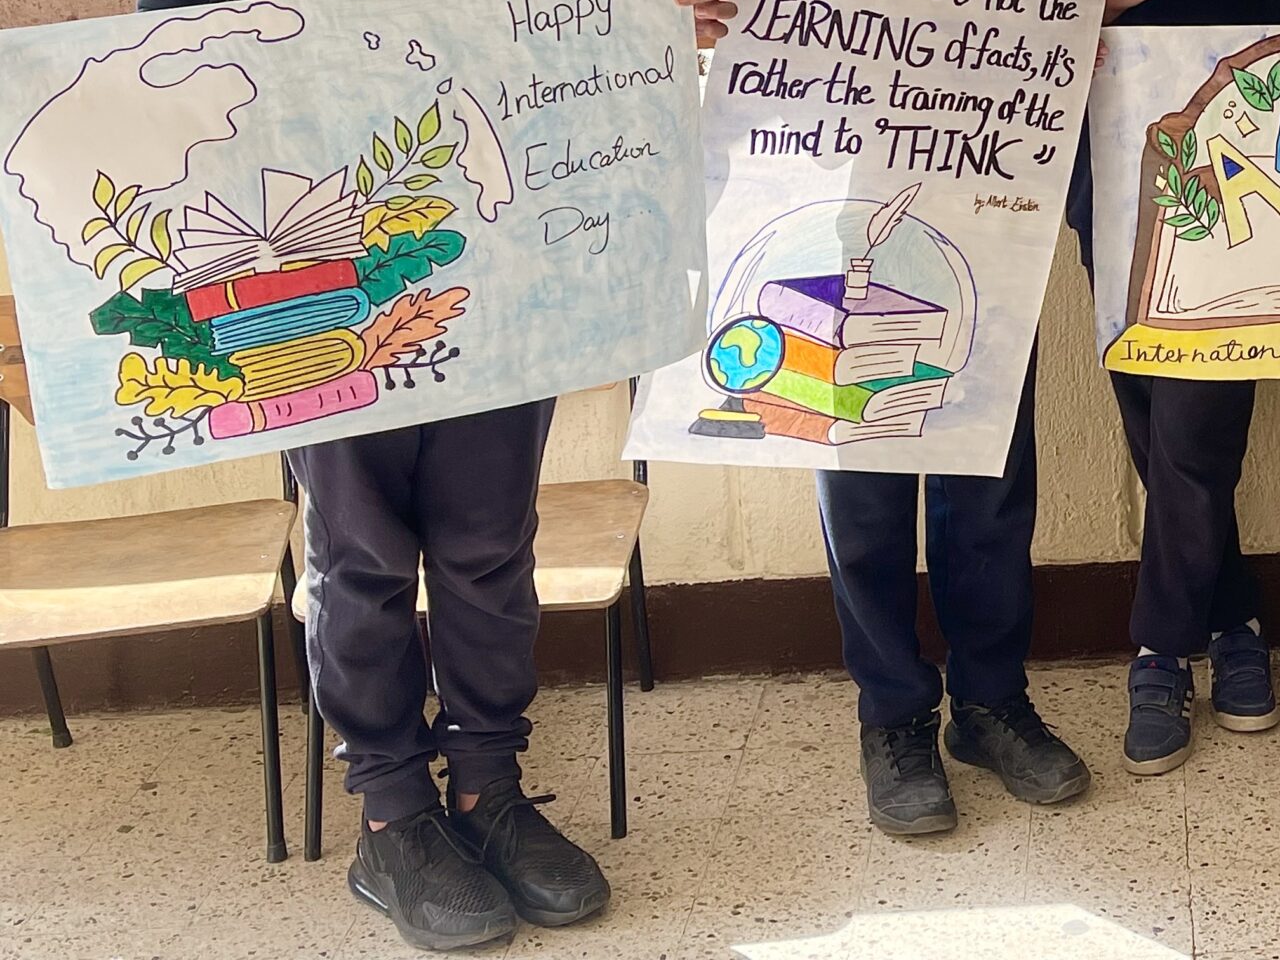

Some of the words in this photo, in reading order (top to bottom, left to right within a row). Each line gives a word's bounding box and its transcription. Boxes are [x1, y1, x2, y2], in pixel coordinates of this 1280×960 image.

[498, 45, 674, 121] International
[944, 21, 974, 69] of
[1041, 44, 1076, 87] it's
[727, 57, 824, 102] rather
[822, 62, 876, 106] the
[889, 69, 995, 140] training
[998, 88, 1027, 124] of
[1024, 93, 1065, 133] the
[522, 134, 660, 192] Education
[749, 118, 824, 158] mind
[834, 117, 863, 155] to
[537, 207, 611, 255] Day
